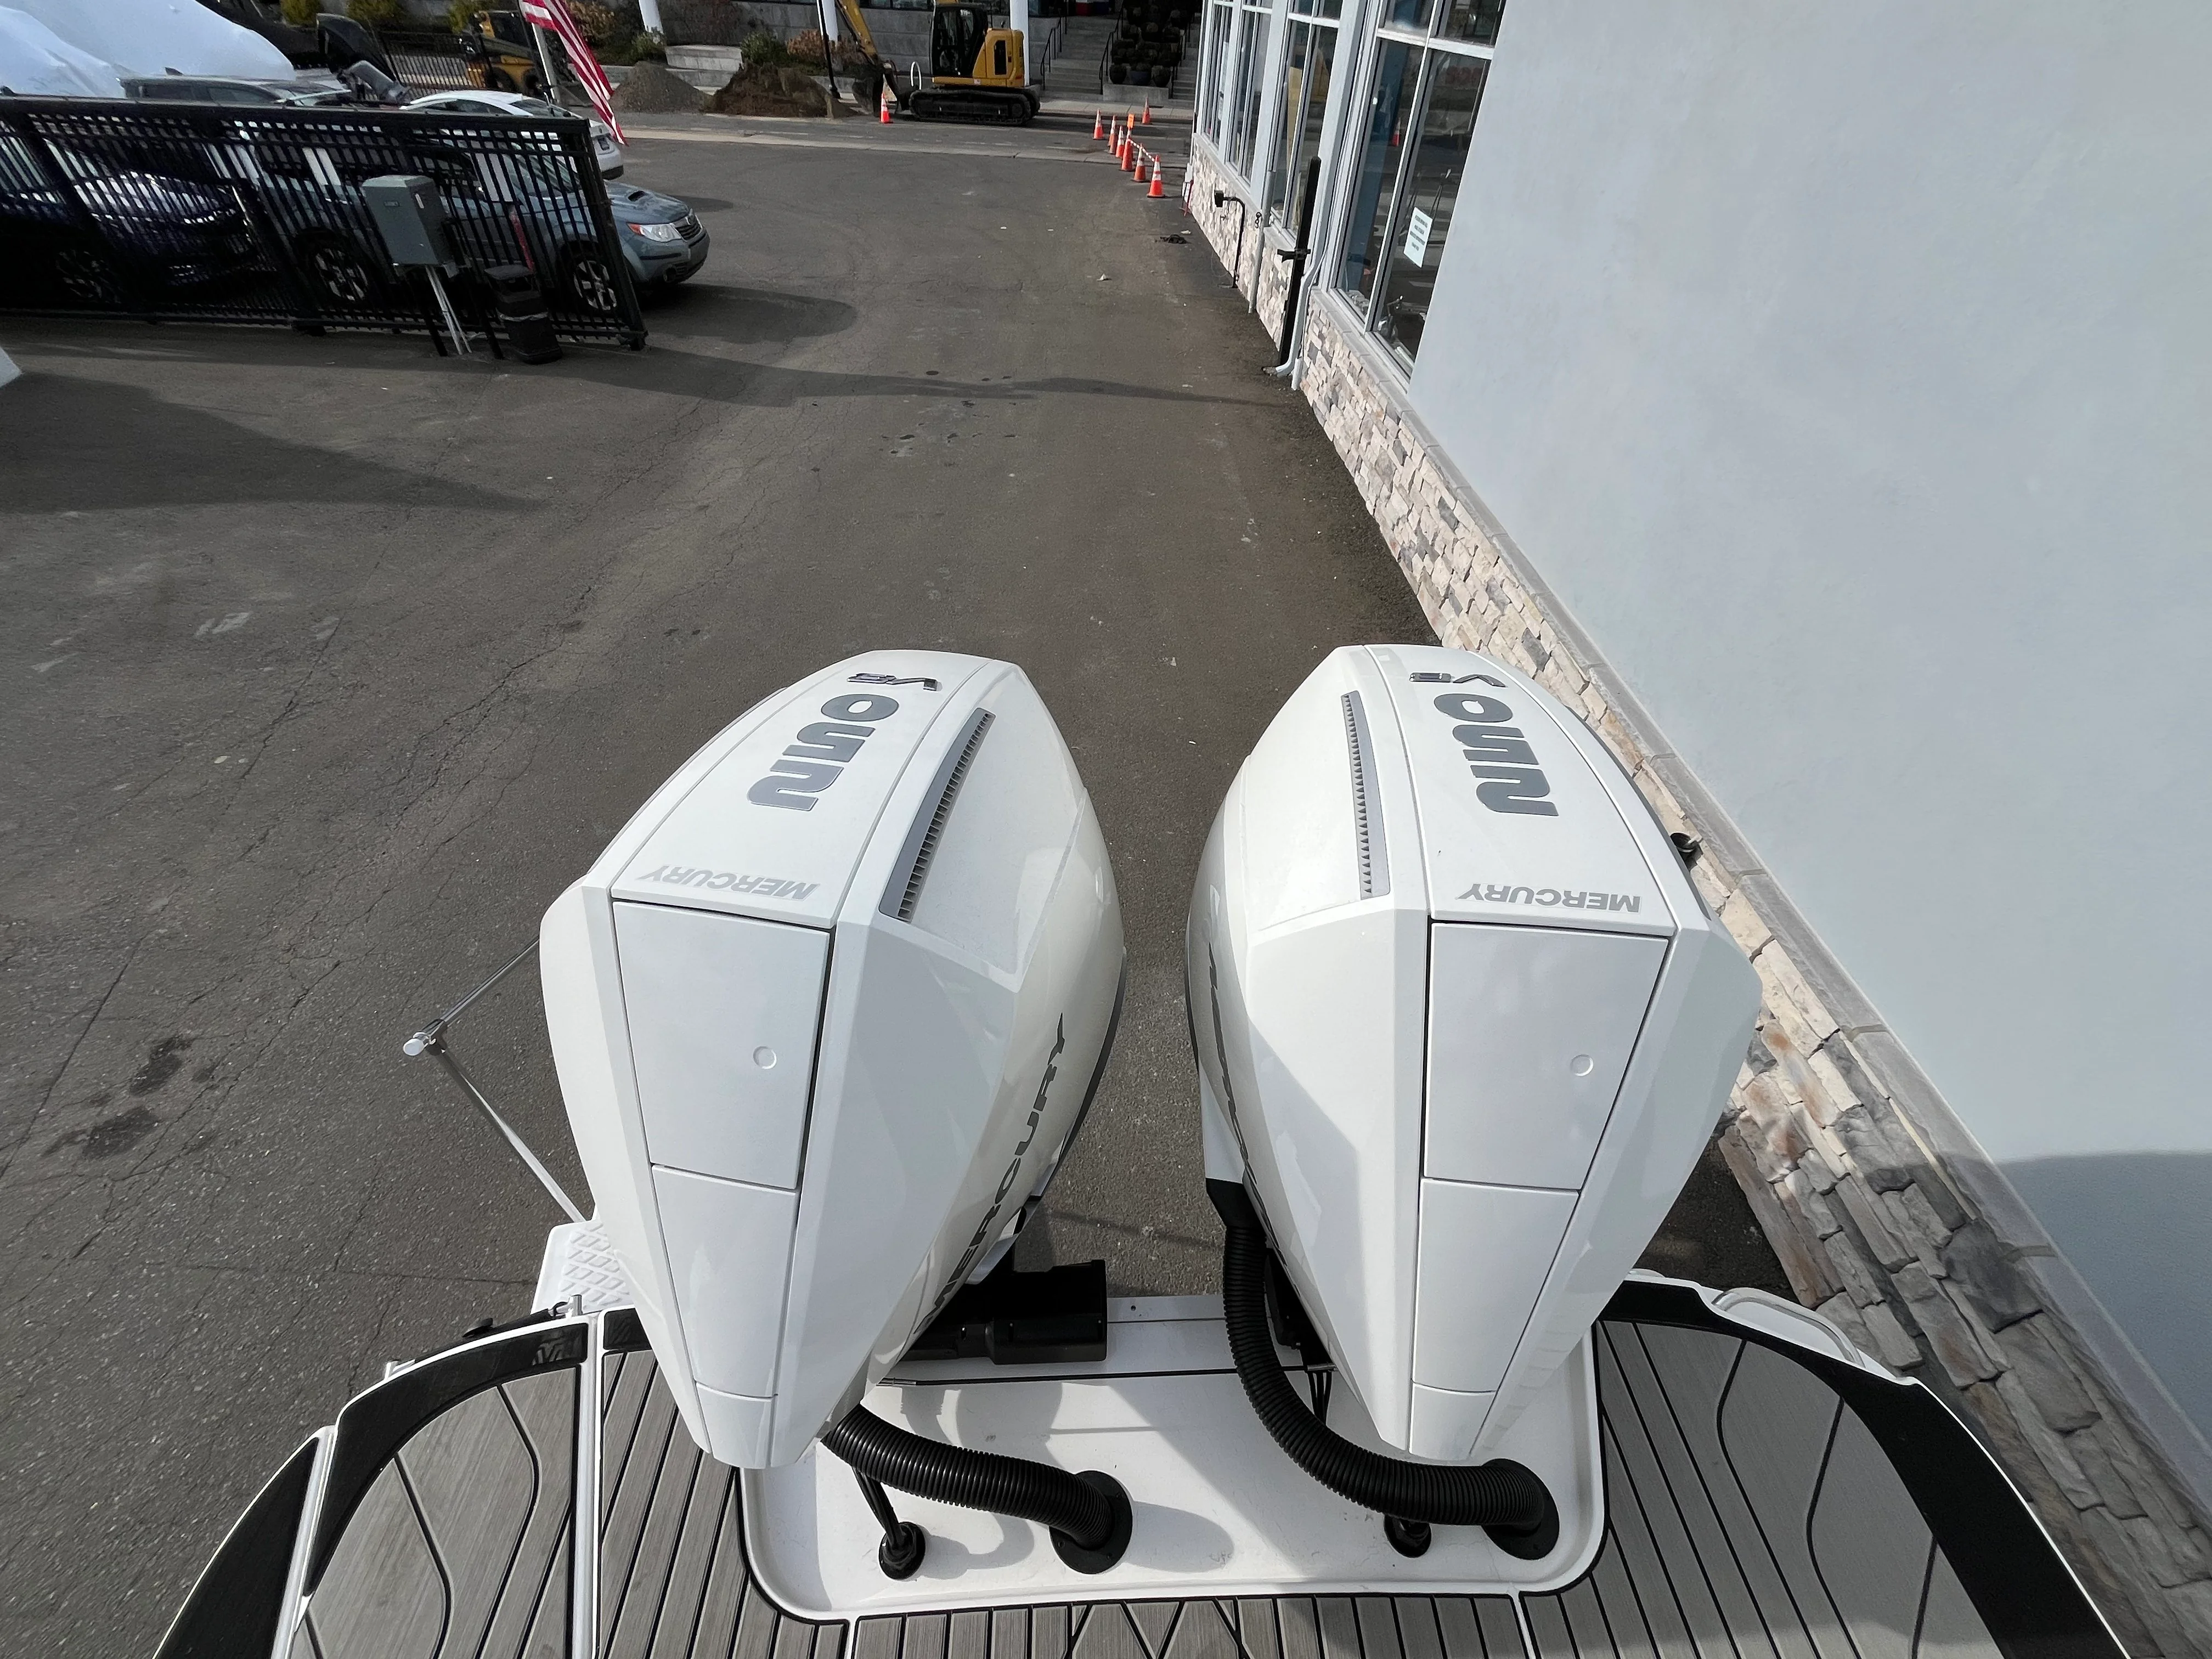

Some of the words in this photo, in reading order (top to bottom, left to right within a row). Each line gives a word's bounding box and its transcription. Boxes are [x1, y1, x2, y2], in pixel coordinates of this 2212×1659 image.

[747, 693, 899, 812] 250
[1434, 693, 1559, 817] 250
[637, 865, 821, 900] MERCURY
[1456, 883, 1641, 913] MERCURY
